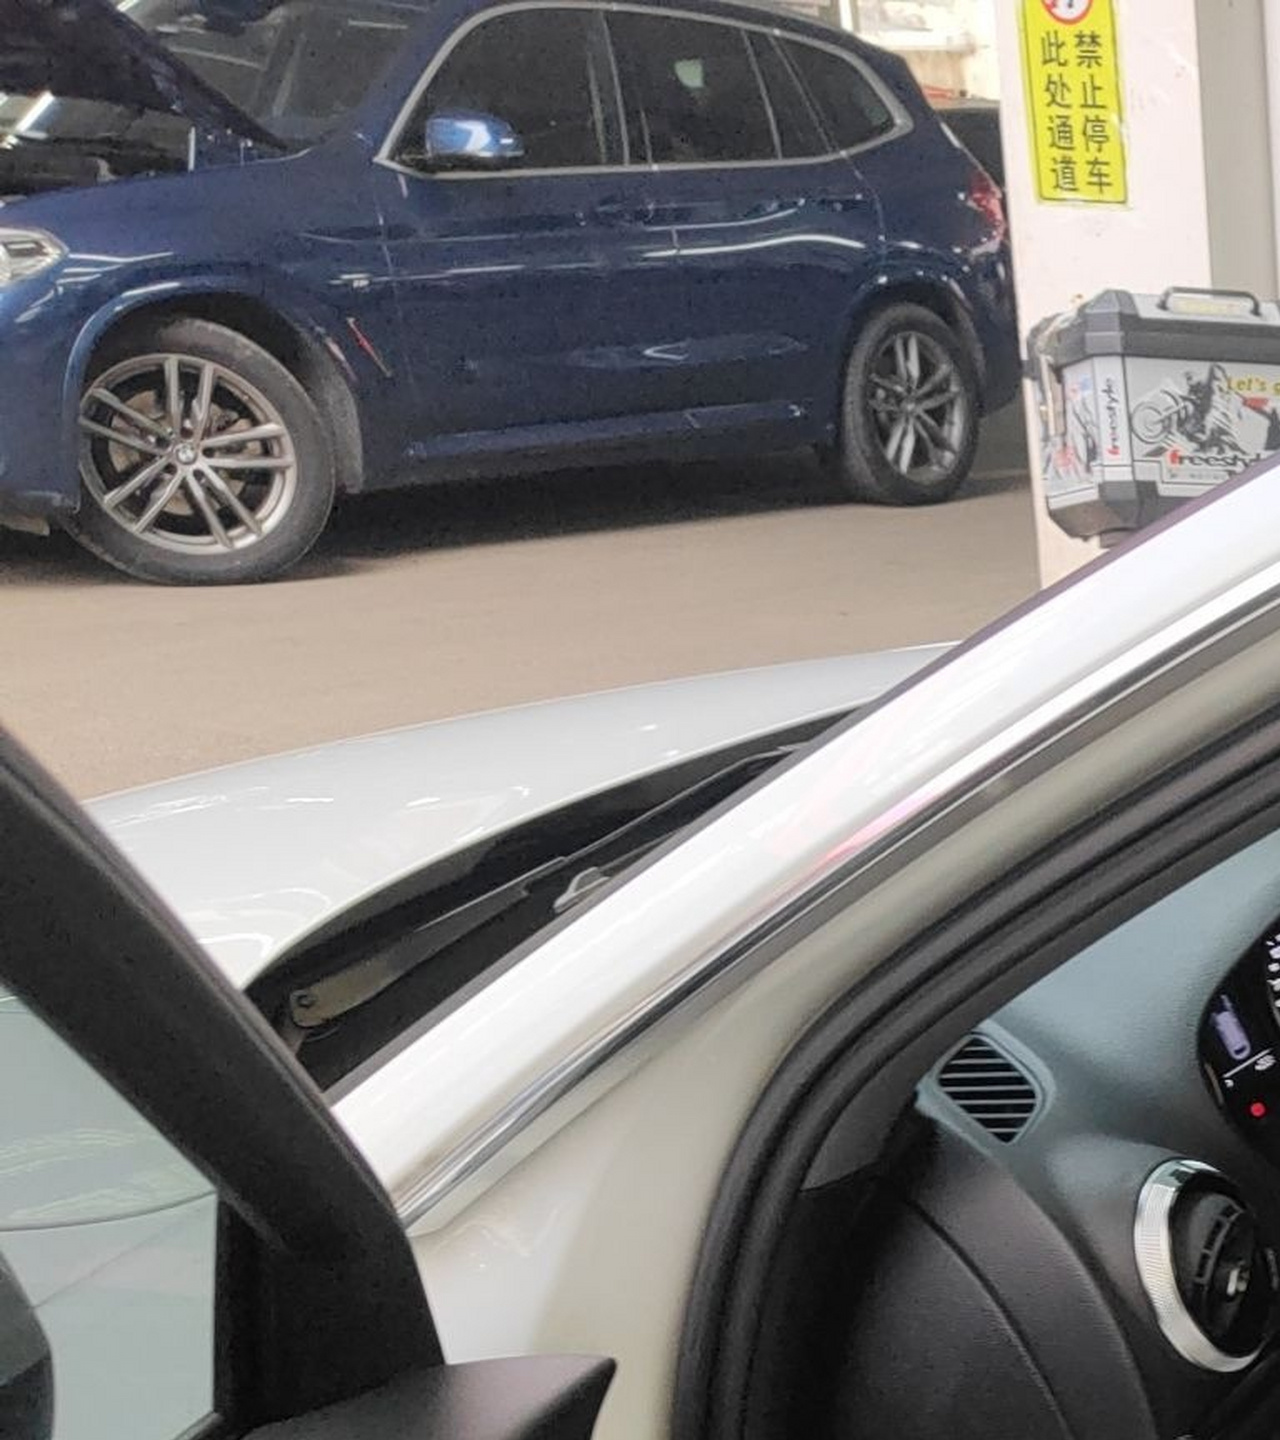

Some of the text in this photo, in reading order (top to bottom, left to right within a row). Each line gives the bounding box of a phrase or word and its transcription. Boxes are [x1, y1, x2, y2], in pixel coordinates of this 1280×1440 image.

[1041, 29, 1080, 192] 此处通道
[1074, 30, 1113, 194] 禁止停车
[1227, 377, 1267, 391] Let's
